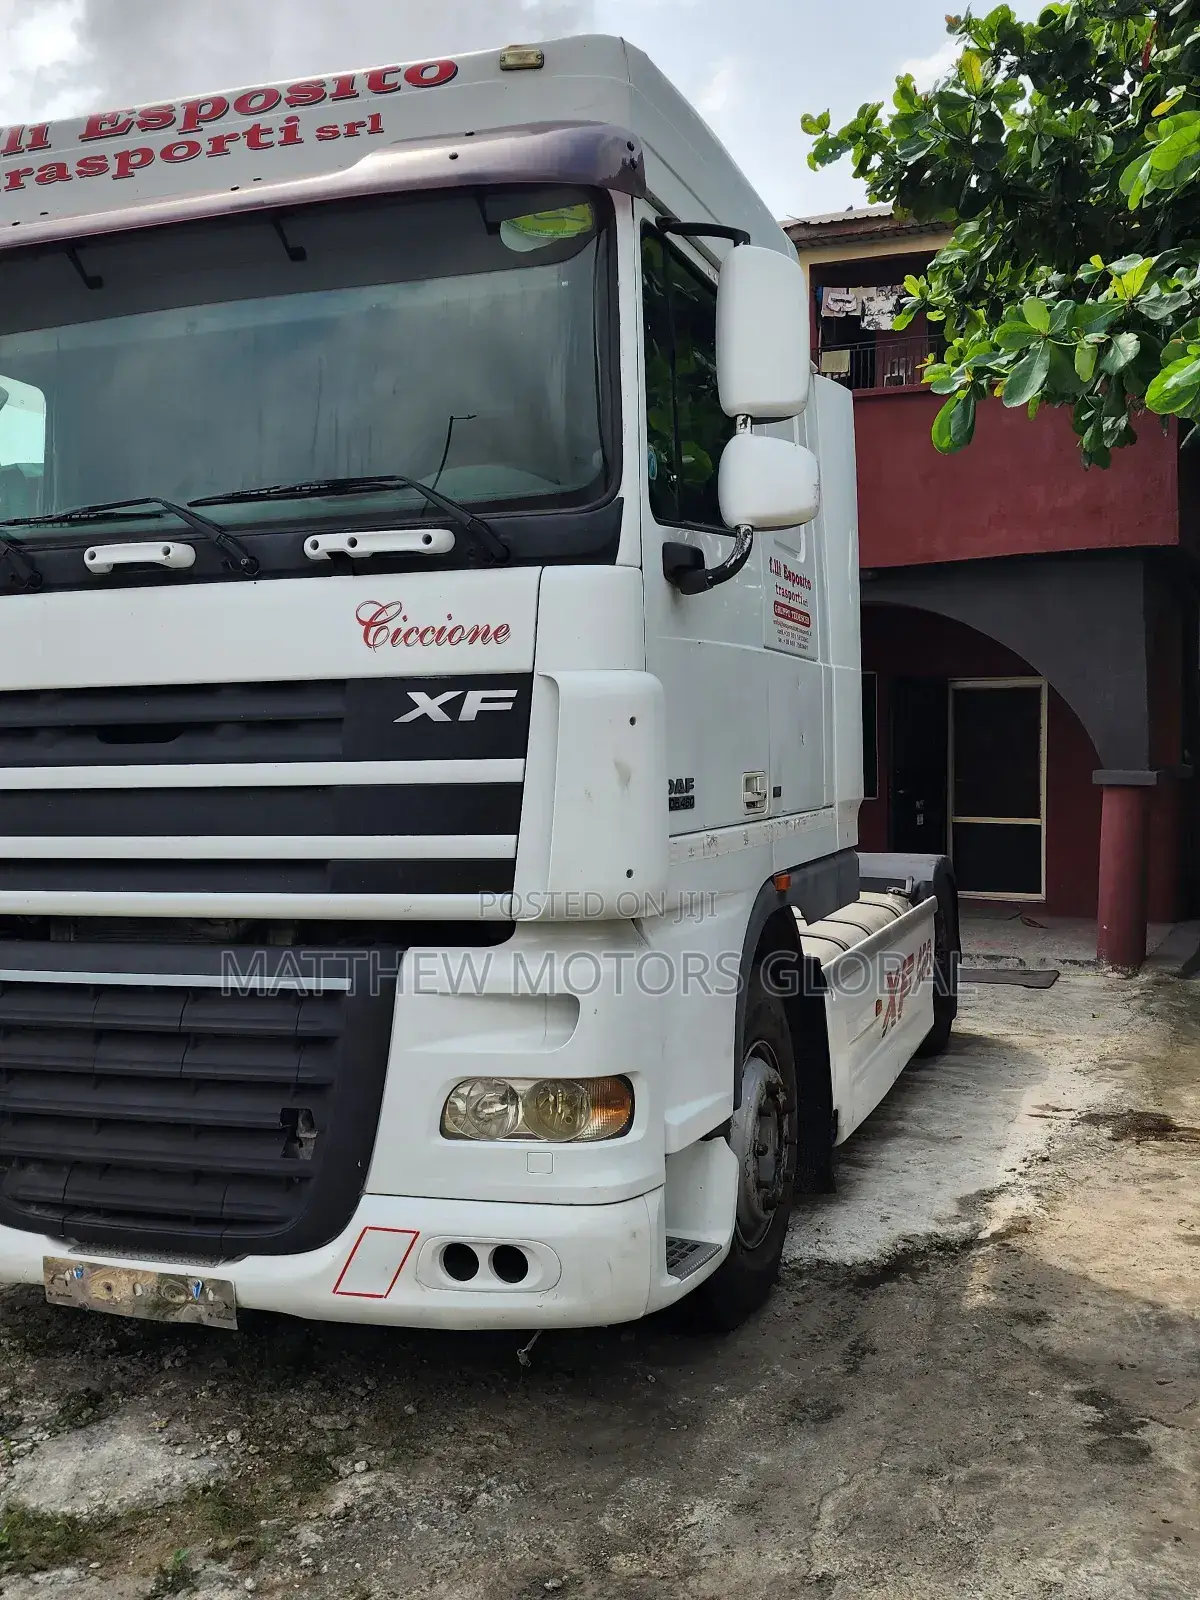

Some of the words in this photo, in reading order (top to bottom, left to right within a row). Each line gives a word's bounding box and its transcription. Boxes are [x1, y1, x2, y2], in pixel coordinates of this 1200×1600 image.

[0, 123, 52, 158] li
[79, 58, 459, 142] Esposito
[0, 116, 304, 192] rasporti
[315, 113, 385, 141] srl
[775, 582, 803, 605] trasporti
[783, 563, 812, 591] Esposito
[355, 600, 511, 653] Ciccione
[392, 689, 518, 723] XF
